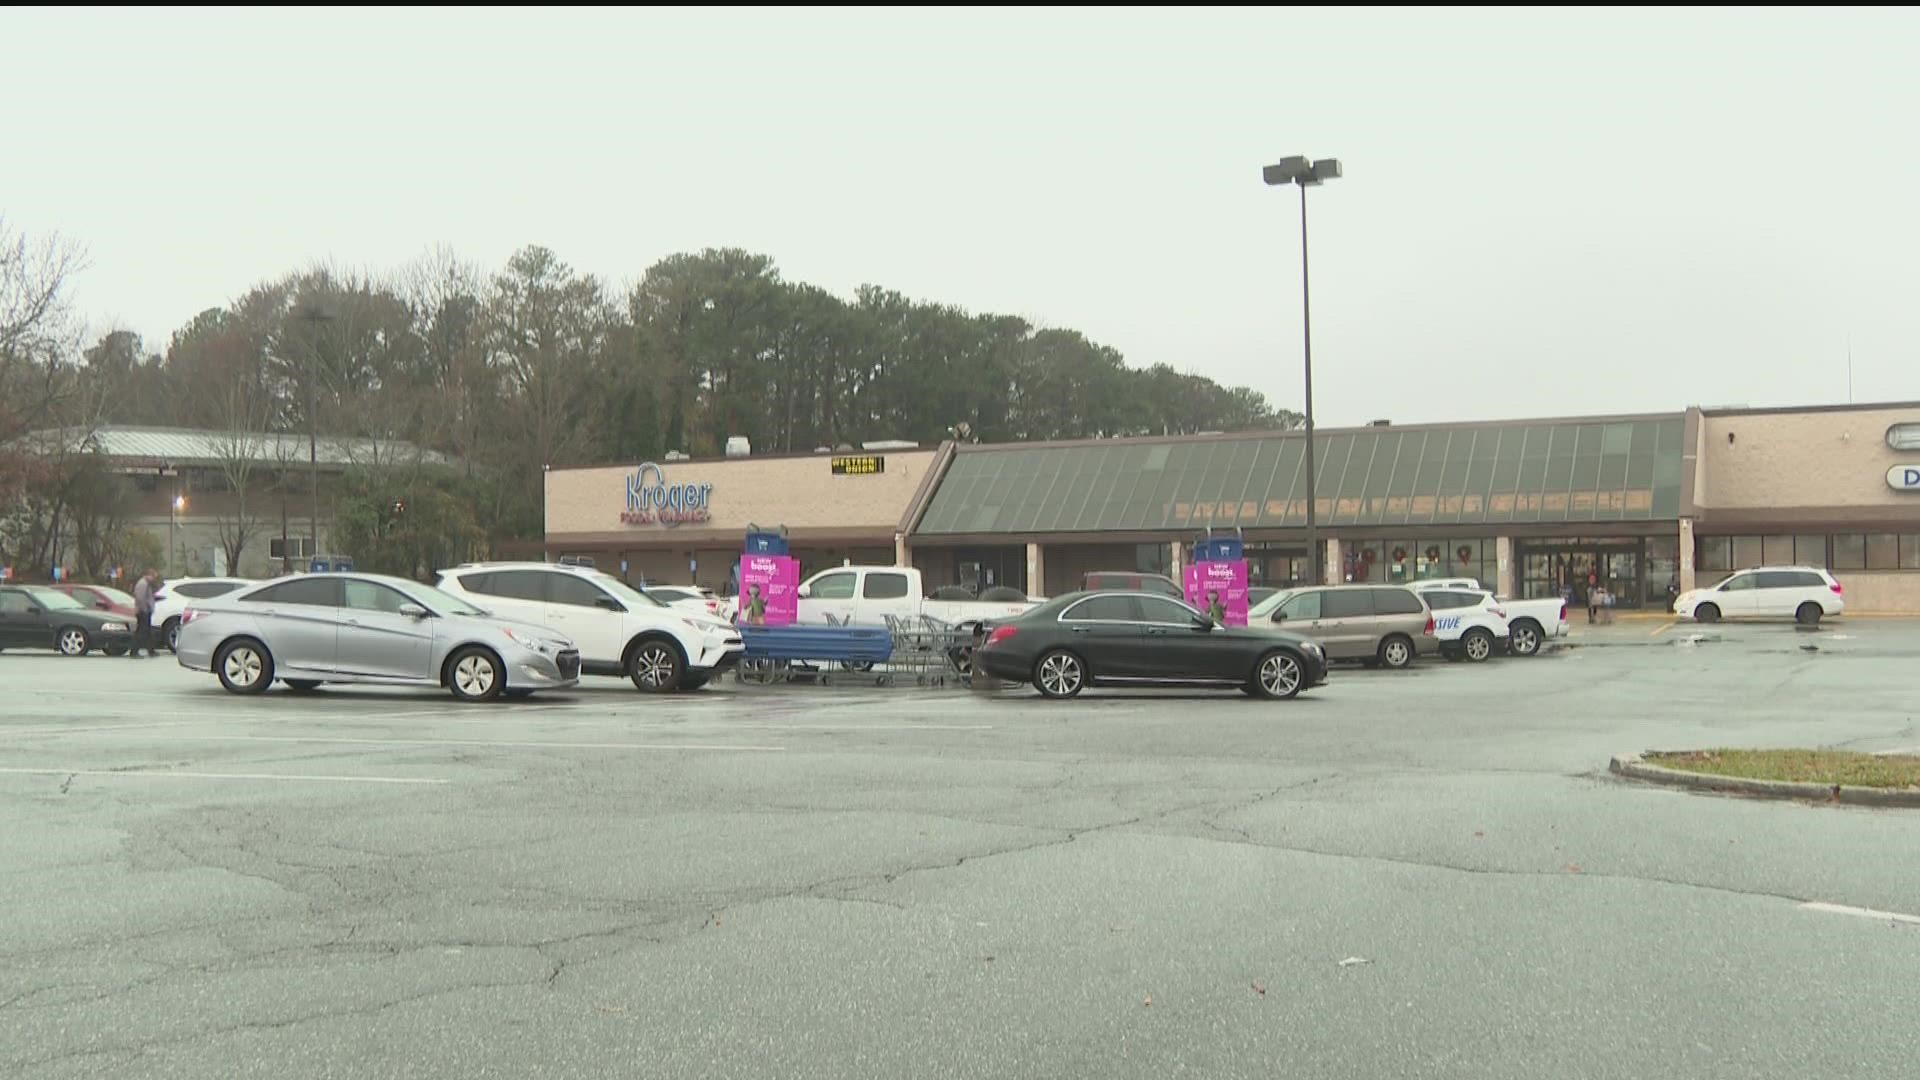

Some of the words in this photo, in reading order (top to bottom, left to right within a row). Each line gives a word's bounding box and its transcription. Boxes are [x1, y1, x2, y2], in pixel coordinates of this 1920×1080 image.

[832, 457, 875, 466] WESTERN
[845, 464, 875, 473] UNION
[626, 462, 712, 513] Kroger
